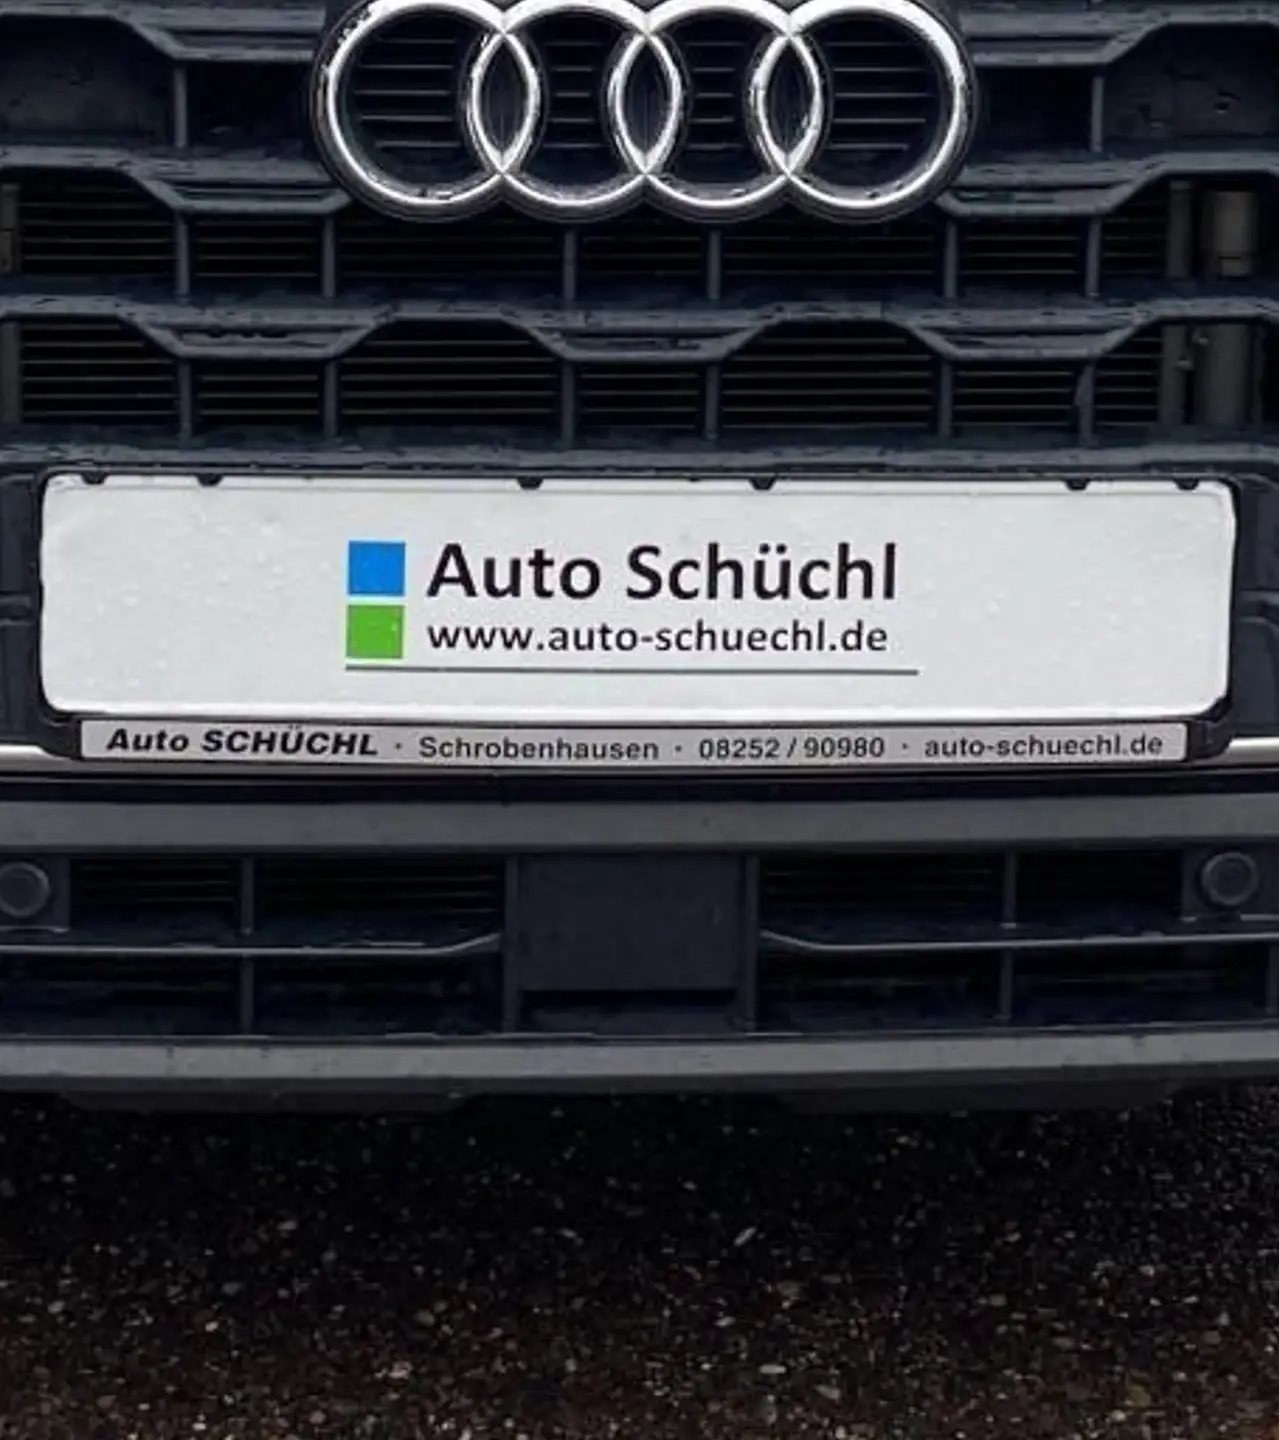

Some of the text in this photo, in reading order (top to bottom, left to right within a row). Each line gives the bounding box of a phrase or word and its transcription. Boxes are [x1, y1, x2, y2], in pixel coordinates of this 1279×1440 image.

[426, 542, 896, 601] Auto Schüchl
[427, 620, 888, 652] www.auto-schuechl.de
[106, 727, 190, 753] Auto
[201, 725, 379, 757] SCHÜCHL
[419, 735, 659, 760] Schrobenhausen
[924, 733, 1163, 758] auto-schuechl.de
